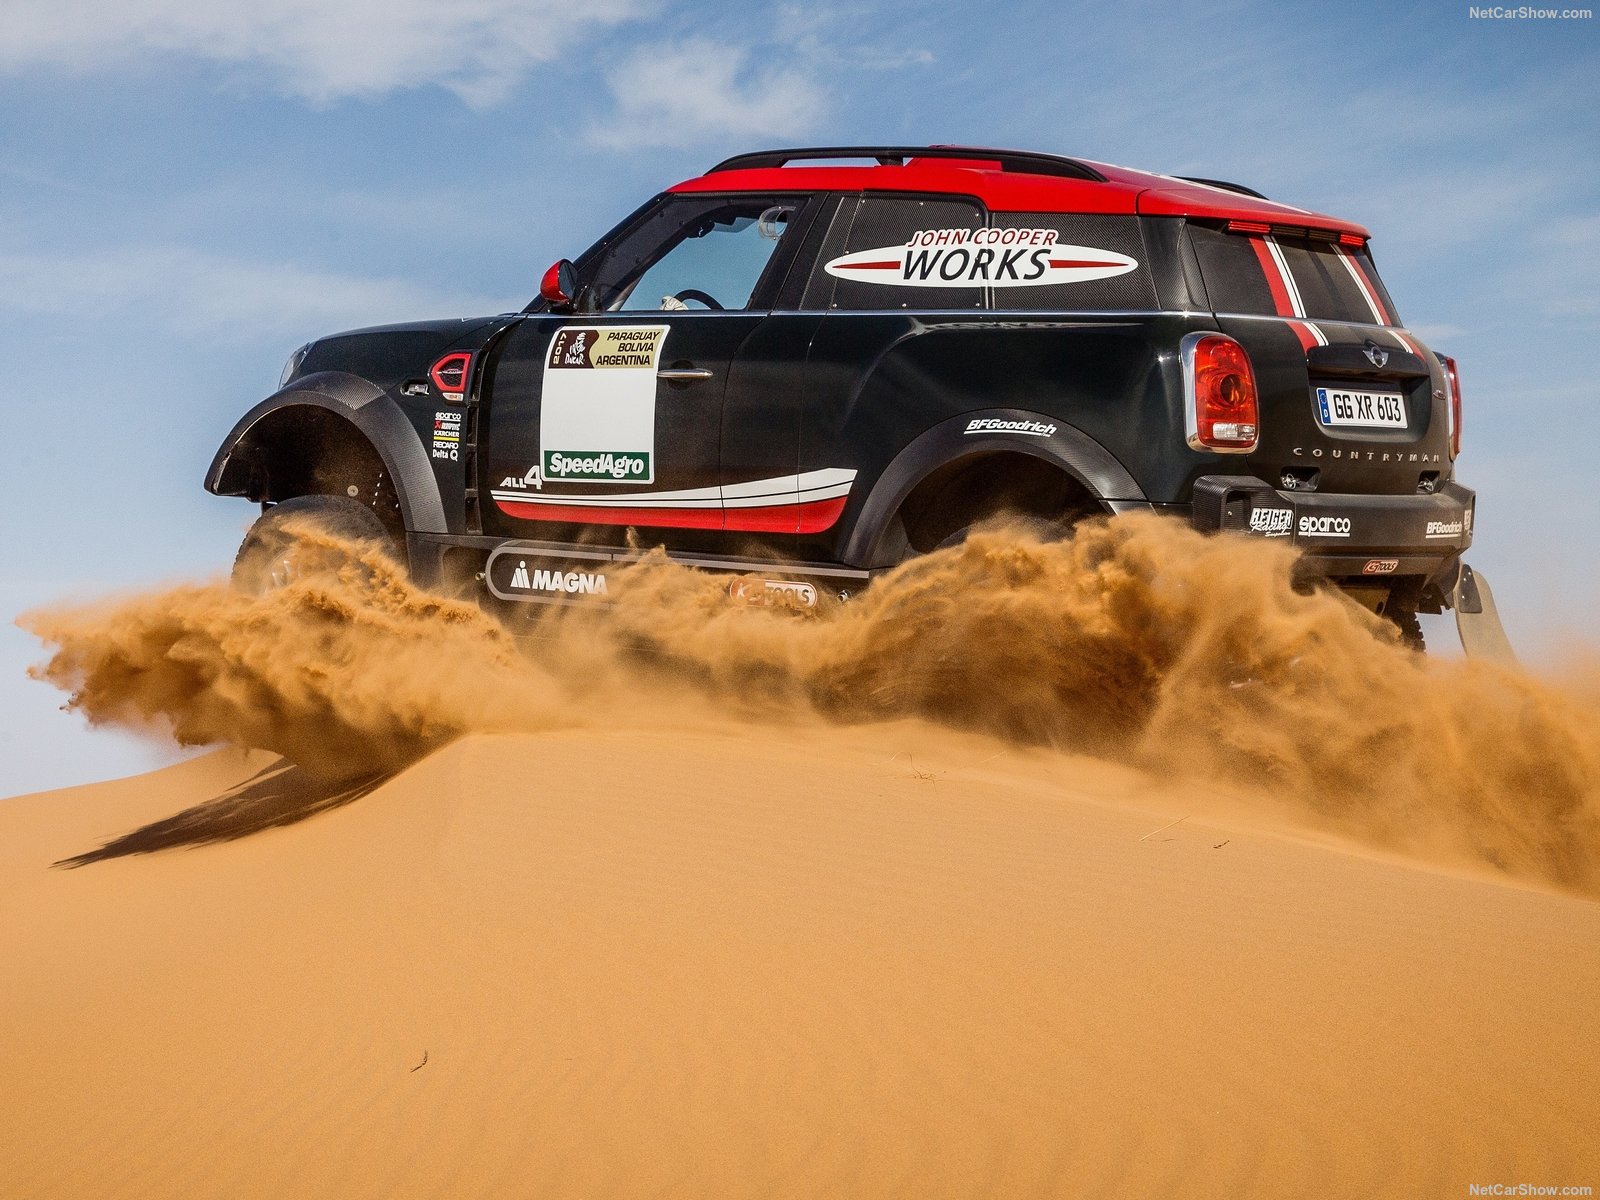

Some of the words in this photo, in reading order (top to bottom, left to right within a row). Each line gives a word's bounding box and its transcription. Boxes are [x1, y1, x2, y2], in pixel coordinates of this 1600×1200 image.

[907, 229, 967, 248] JOHN
[973, 229, 1056, 246] COOPER
[903, 248, 1052, 281] WORKS
[607, 331, 661, 341] PARAGUAY
[553, 332, 567, 365] 2017
[618, 342, 654, 352] BOLIVIA
[596, 355, 651, 366] ARGENTINA
[1333, 394, 1354, 420] GG
[1354, 395, 1375, 420] XR
[1377, 397, 1402, 422] 603
[965, 418, 1058, 435] BFGoodrich
[433, 441, 459, 450] RECARO
[449, 449, 458, 462] Q
[1293, 447, 1440, 463] COUNTRYMAN
[549, 452, 645, 479] SpeedAgro
[499, 465, 543, 490] ALL4
[1298, 516, 1352, 537] sparco
[1426, 521, 1464, 534] BFGoodrich
[532, 569, 608, 595] MAGNA
